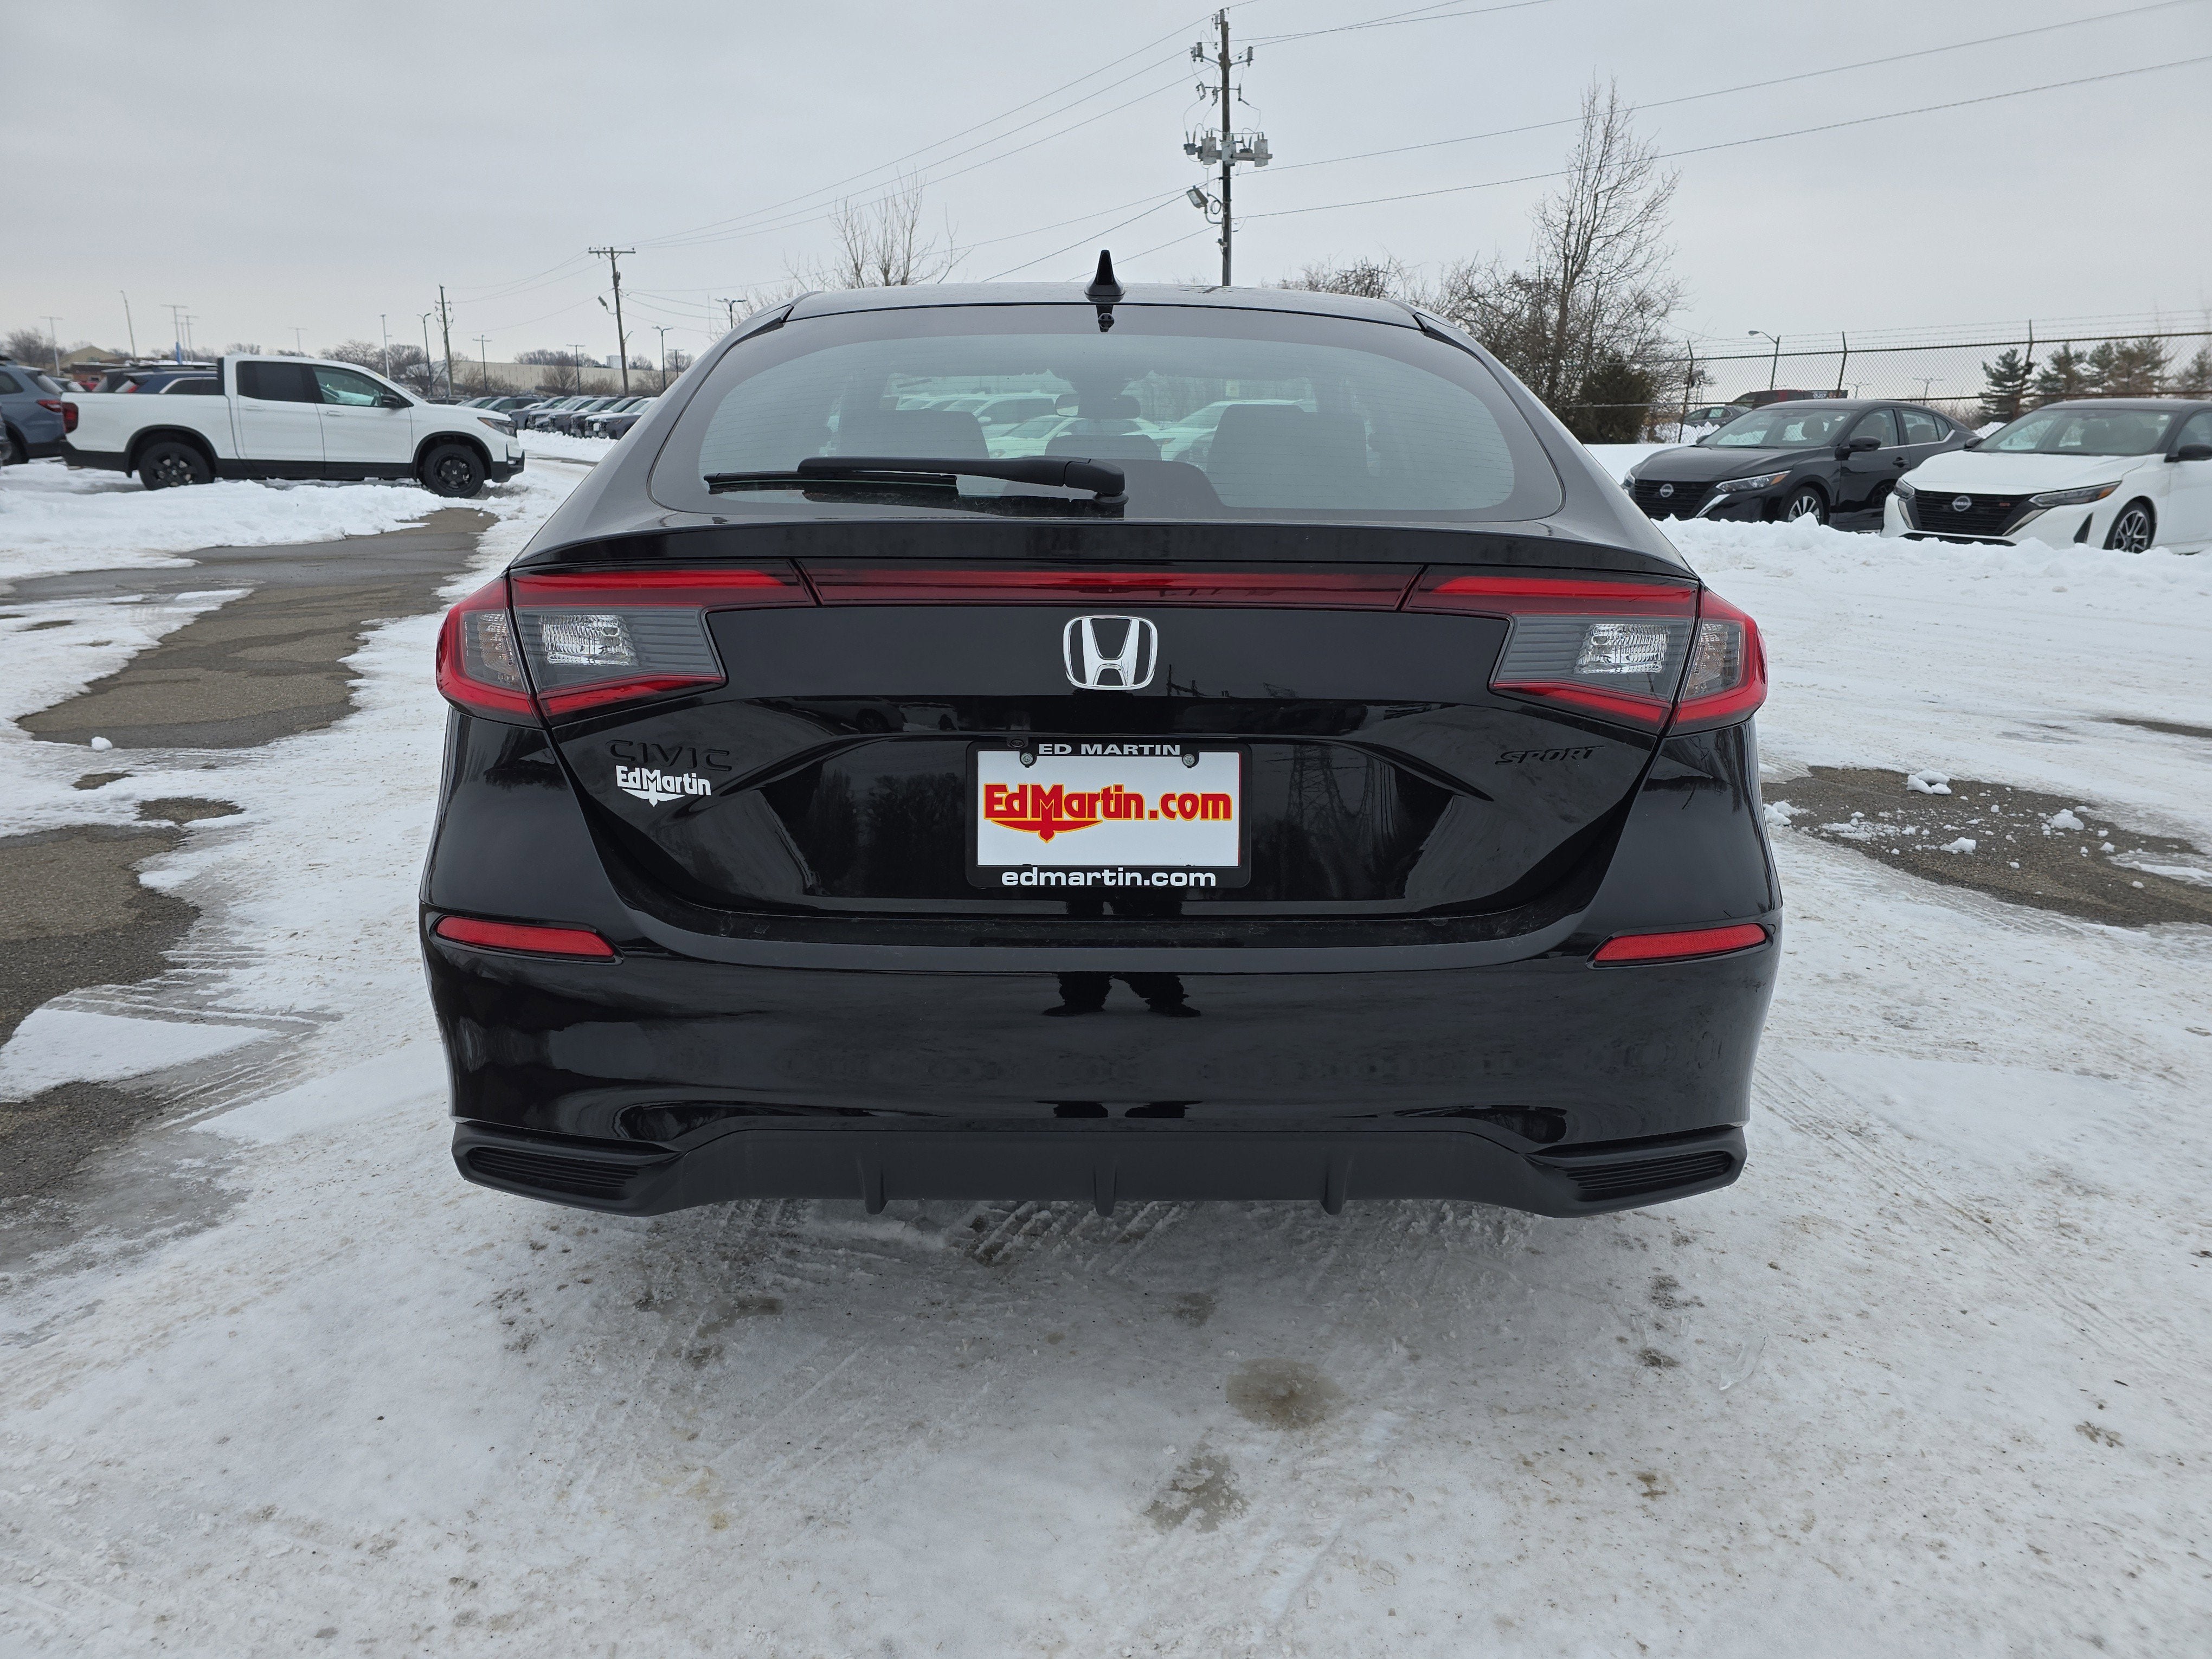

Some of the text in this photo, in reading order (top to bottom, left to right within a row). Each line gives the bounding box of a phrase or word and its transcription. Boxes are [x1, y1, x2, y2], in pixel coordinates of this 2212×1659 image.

[605, 740, 732, 771] CIVIC
[1038, 743, 1181, 755] ED MARTIN
[1495, 745, 1605, 765] SPORT
[1001, 867, 1217, 886] edmartin.com
